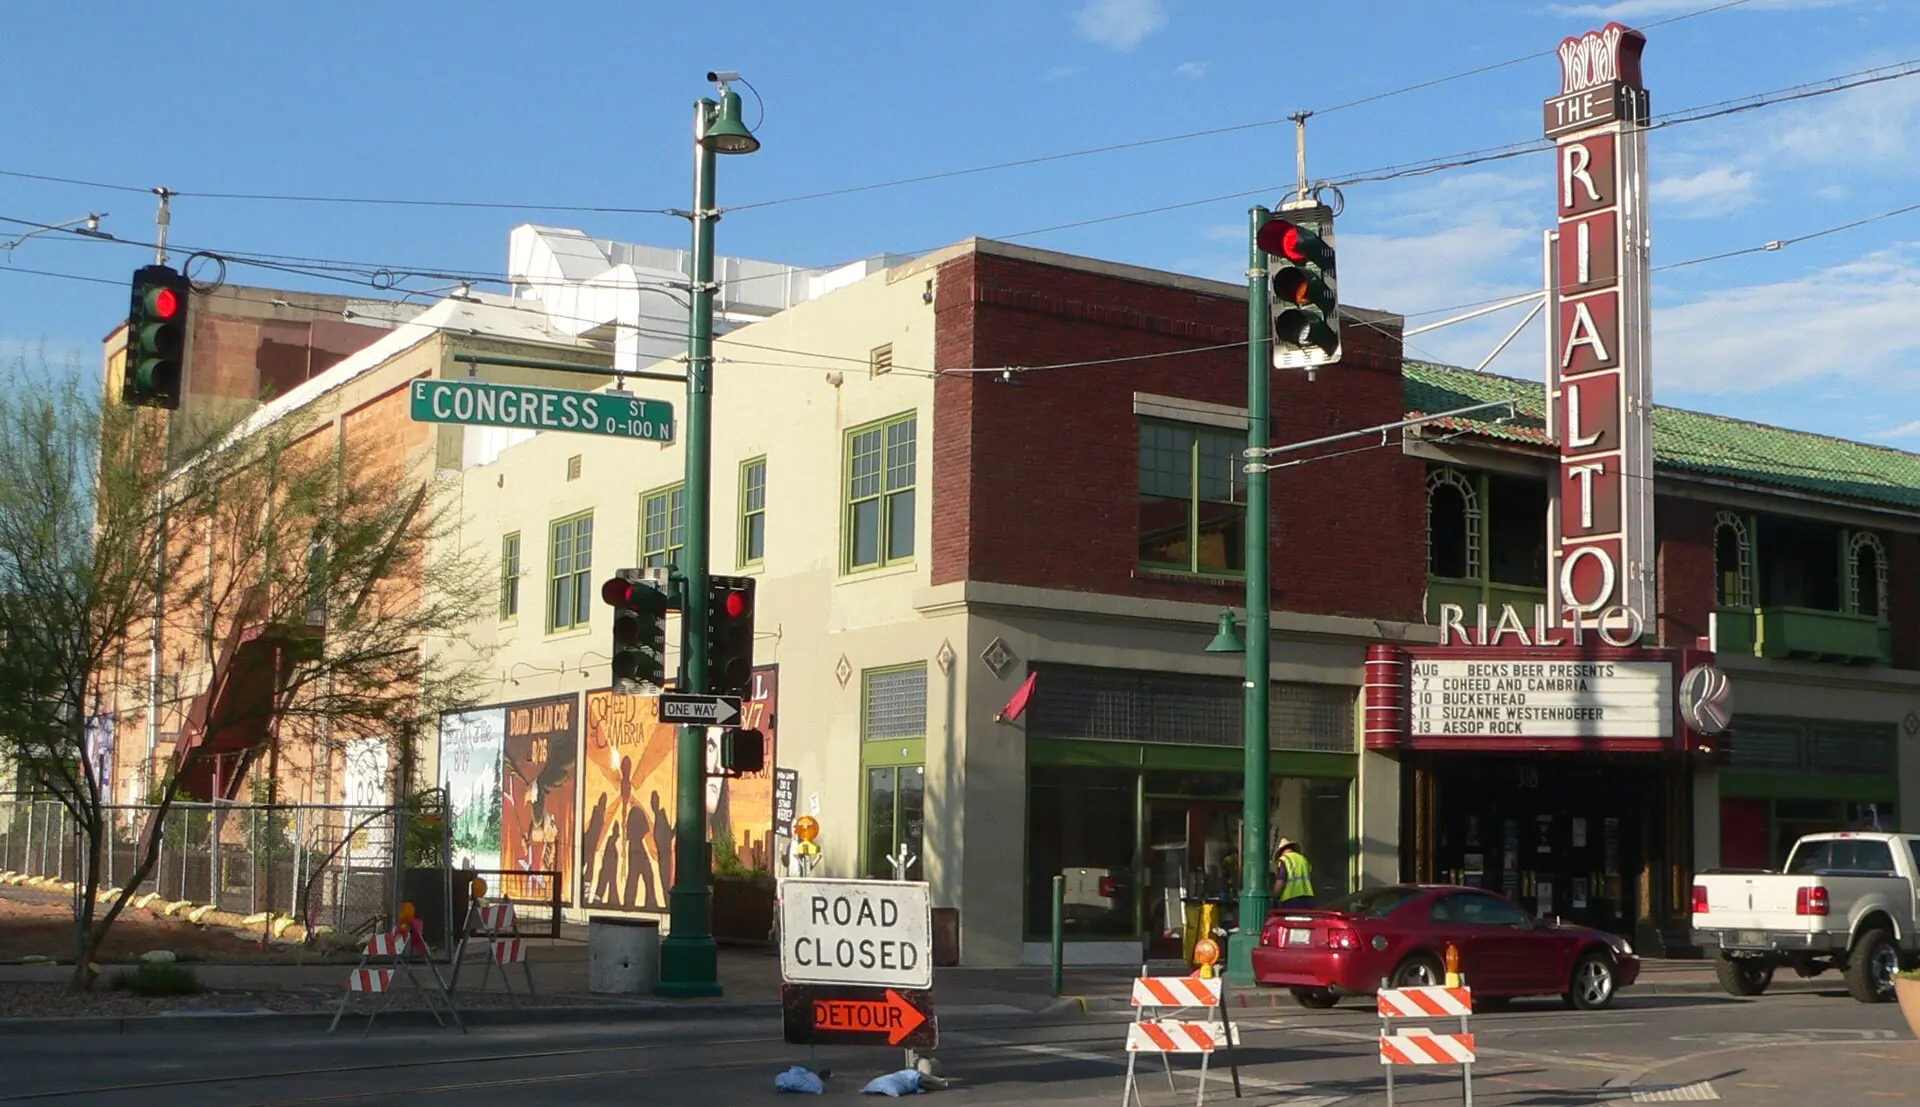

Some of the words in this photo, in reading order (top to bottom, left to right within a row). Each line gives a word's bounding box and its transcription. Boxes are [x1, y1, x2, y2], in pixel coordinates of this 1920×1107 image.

[1556, 94, 1594, 125] THE
[1560, 143, 1617, 613] RIALTO
[416, 383, 426, 400] E
[433, 386, 600, 430] CONGRESS
[629, 401, 647, 418] ST
[606, 420, 653, 438] 0-100
[660, 424, 669, 440] N
[1440, 603, 1644, 647] RIALTO
[1413, 664, 1438, 676] AUG
[1468, 664, 1508, 676] BECKS
[1513, 665, 1544, 677] BEER
[1549, 665, 1614, 677] PRESENTS
[1422, 679, 1430, 690] 7
[1443, 679, 1490, 690] COHEED
[1496, 679, 1522, 690] AND
[1528, 679, 1588, 691] CAMBRIA
[1420, 692, 1432, 704] 10
[1443, 692, 1526, 705] BUCKETHEAD
[554, 703, 570, 731] COE
[668, 704, 690, 716] ONE
[694, 704, 717, 717] WAY
[1420, 707, 1430, 718] 11
[1442, 707, 1500, 719] SUZANNE
[1506, 707, 1604, 720] WESTENHOEFER
[1419, 721, 1431, 733] 13
[1443, 721, 1484, 733] AESOP
[1489, 721, 1522, 734] ROCK
[811, 896, 899, 928] ROAD
[795, 936, 918, 970] CLOSED
[814, 1004, 903, 1028] DETOUR
